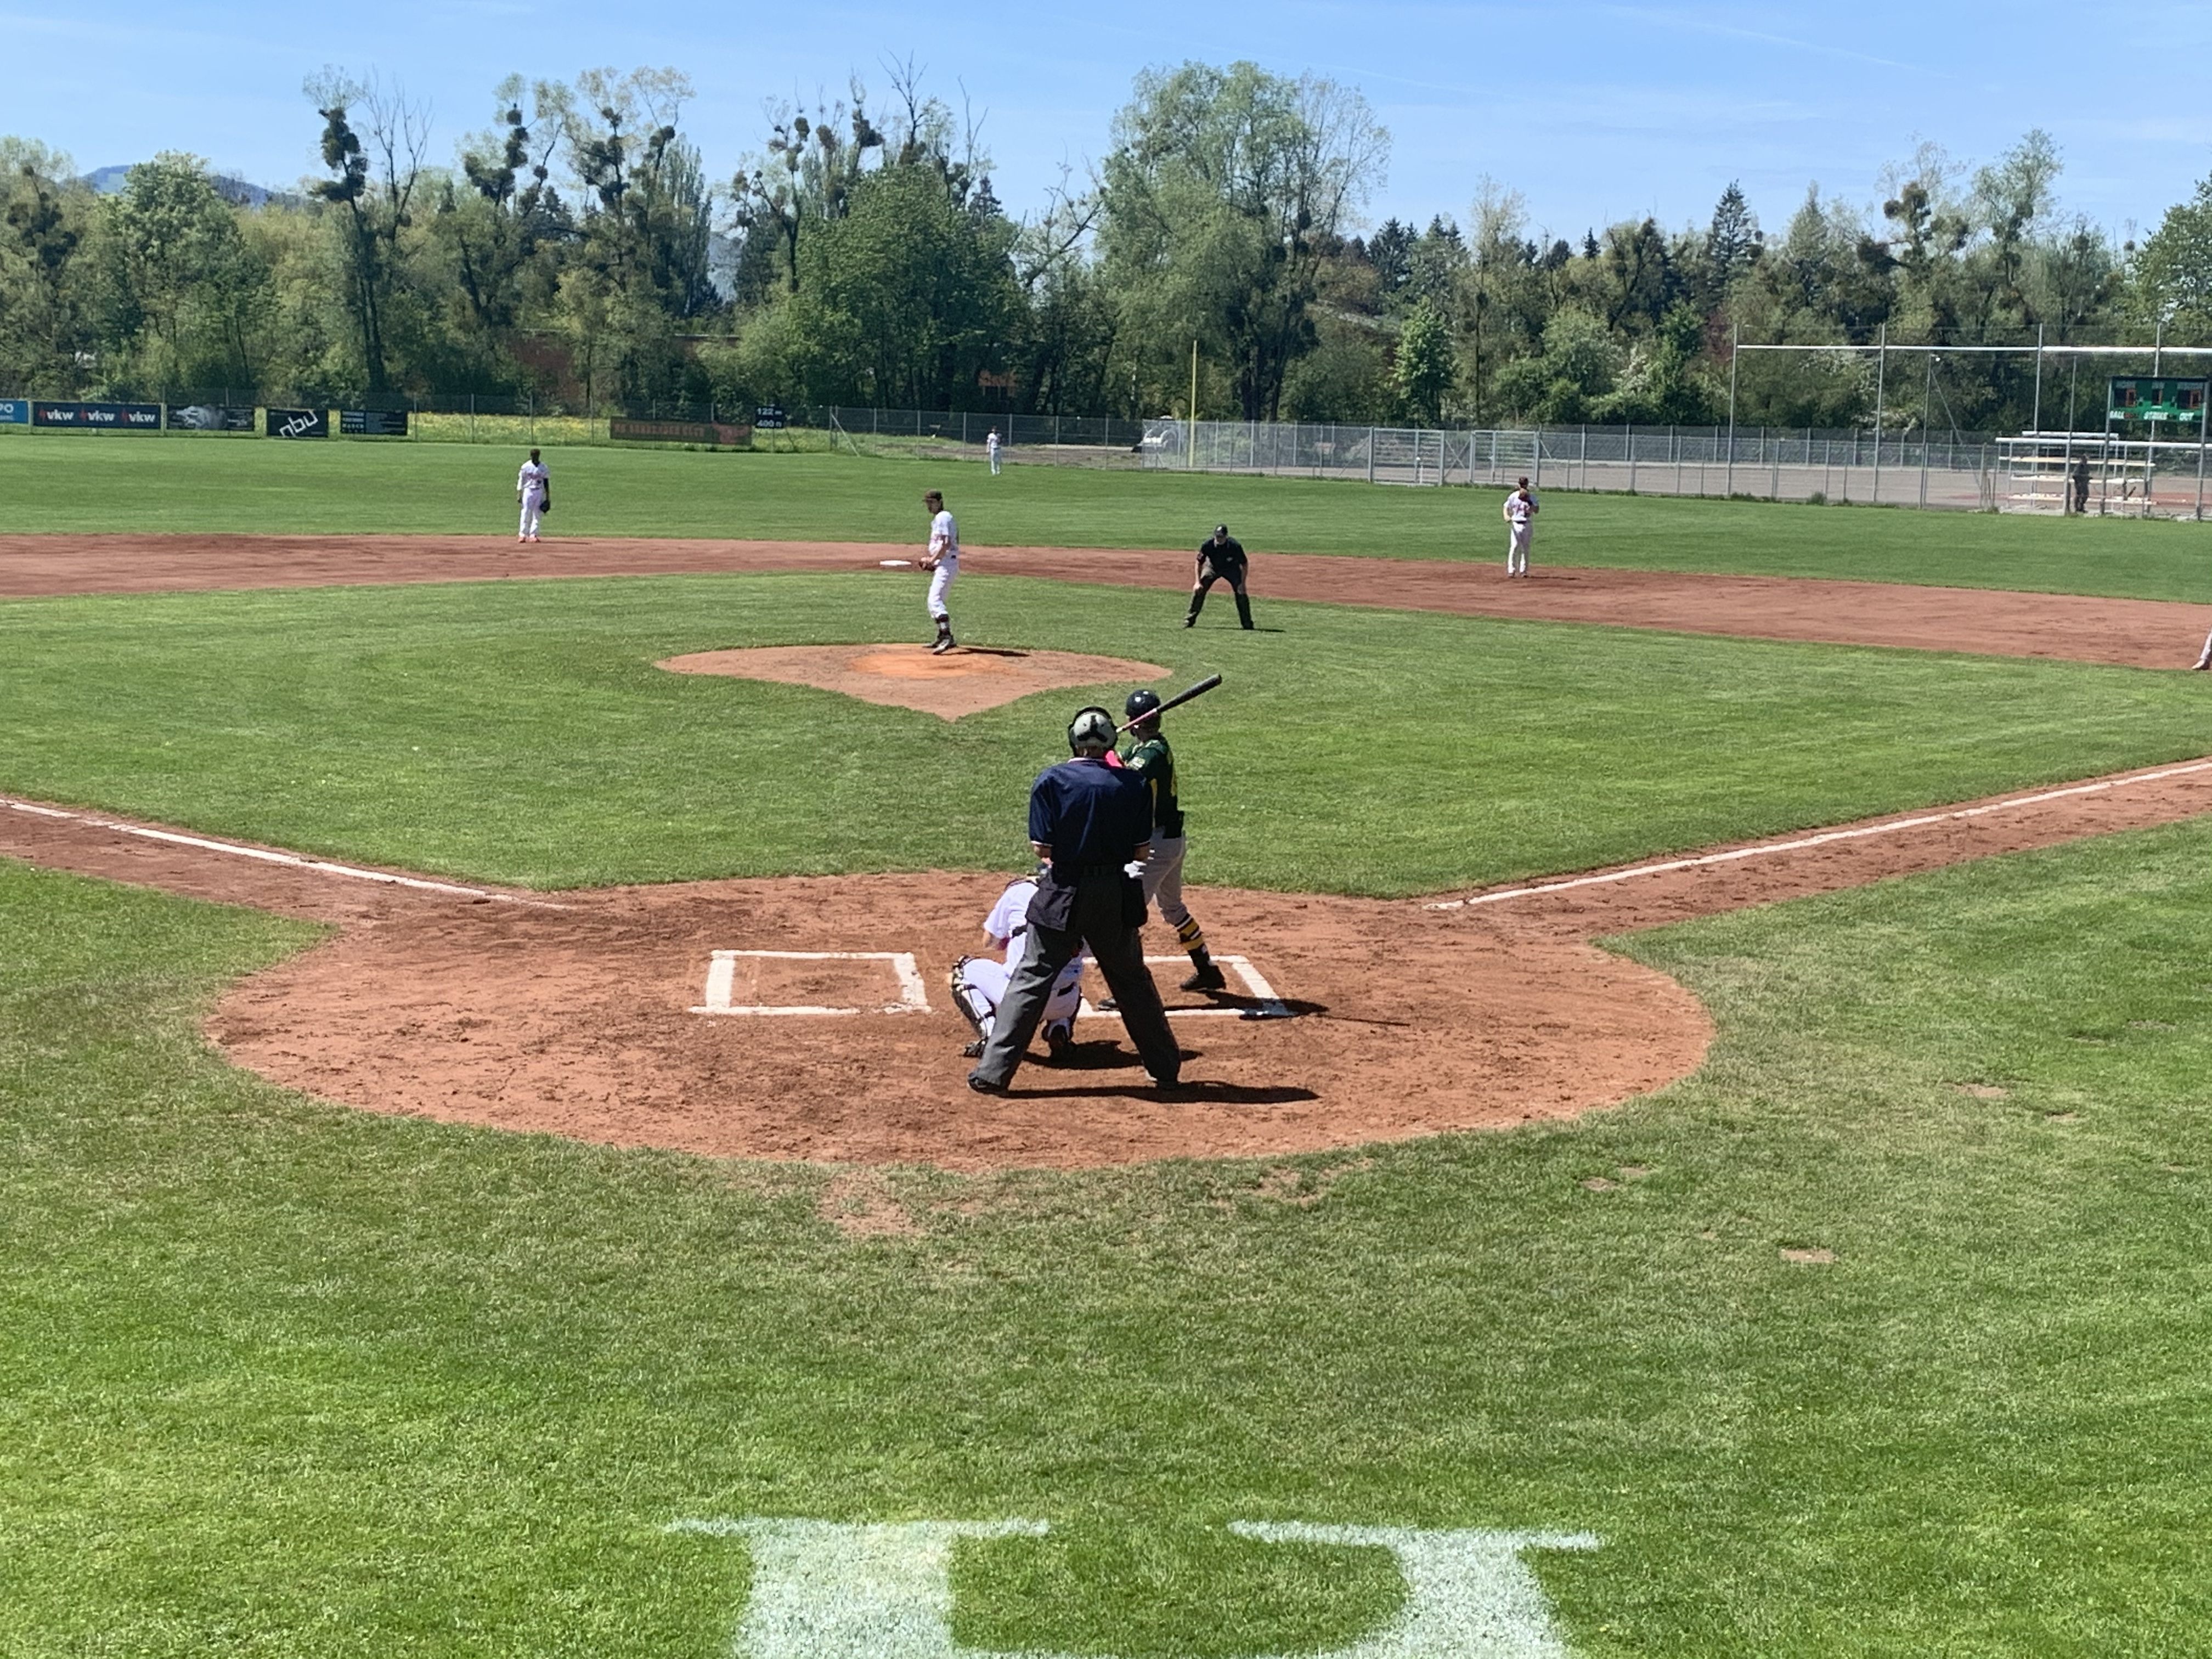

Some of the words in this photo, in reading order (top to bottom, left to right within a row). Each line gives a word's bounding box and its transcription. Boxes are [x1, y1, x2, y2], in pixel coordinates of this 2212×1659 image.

[47, 409, 74, 421] vkw
[87, 410, 115, 422] vkw
[128, 411, 156, 422] vkw
